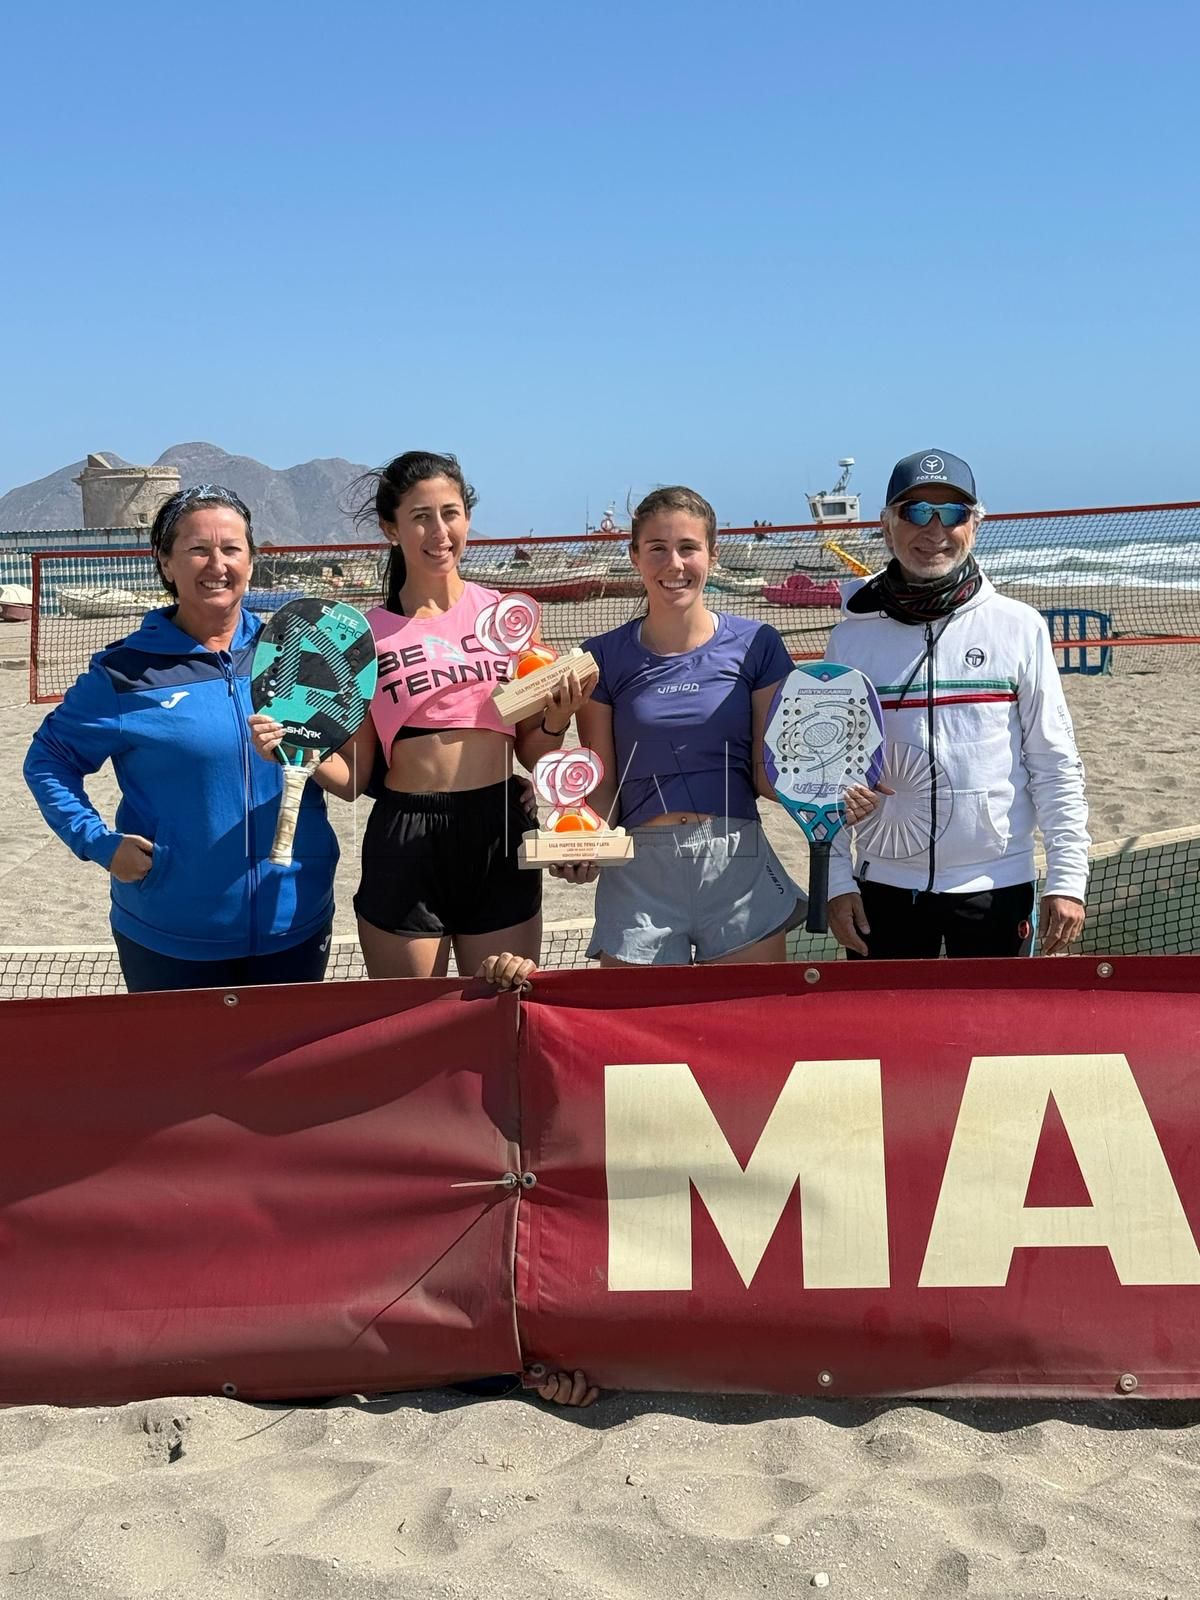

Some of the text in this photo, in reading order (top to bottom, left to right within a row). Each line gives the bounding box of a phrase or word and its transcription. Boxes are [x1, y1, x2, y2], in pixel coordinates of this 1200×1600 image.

[321, 605, 359, 628] ELITE
[336, 622, 363, 640] PRO
[382, 659, 509, 704] TENNIS
[285, 725, 322, 739] SHARK
[604, 1053, 1200, 1290] MA
